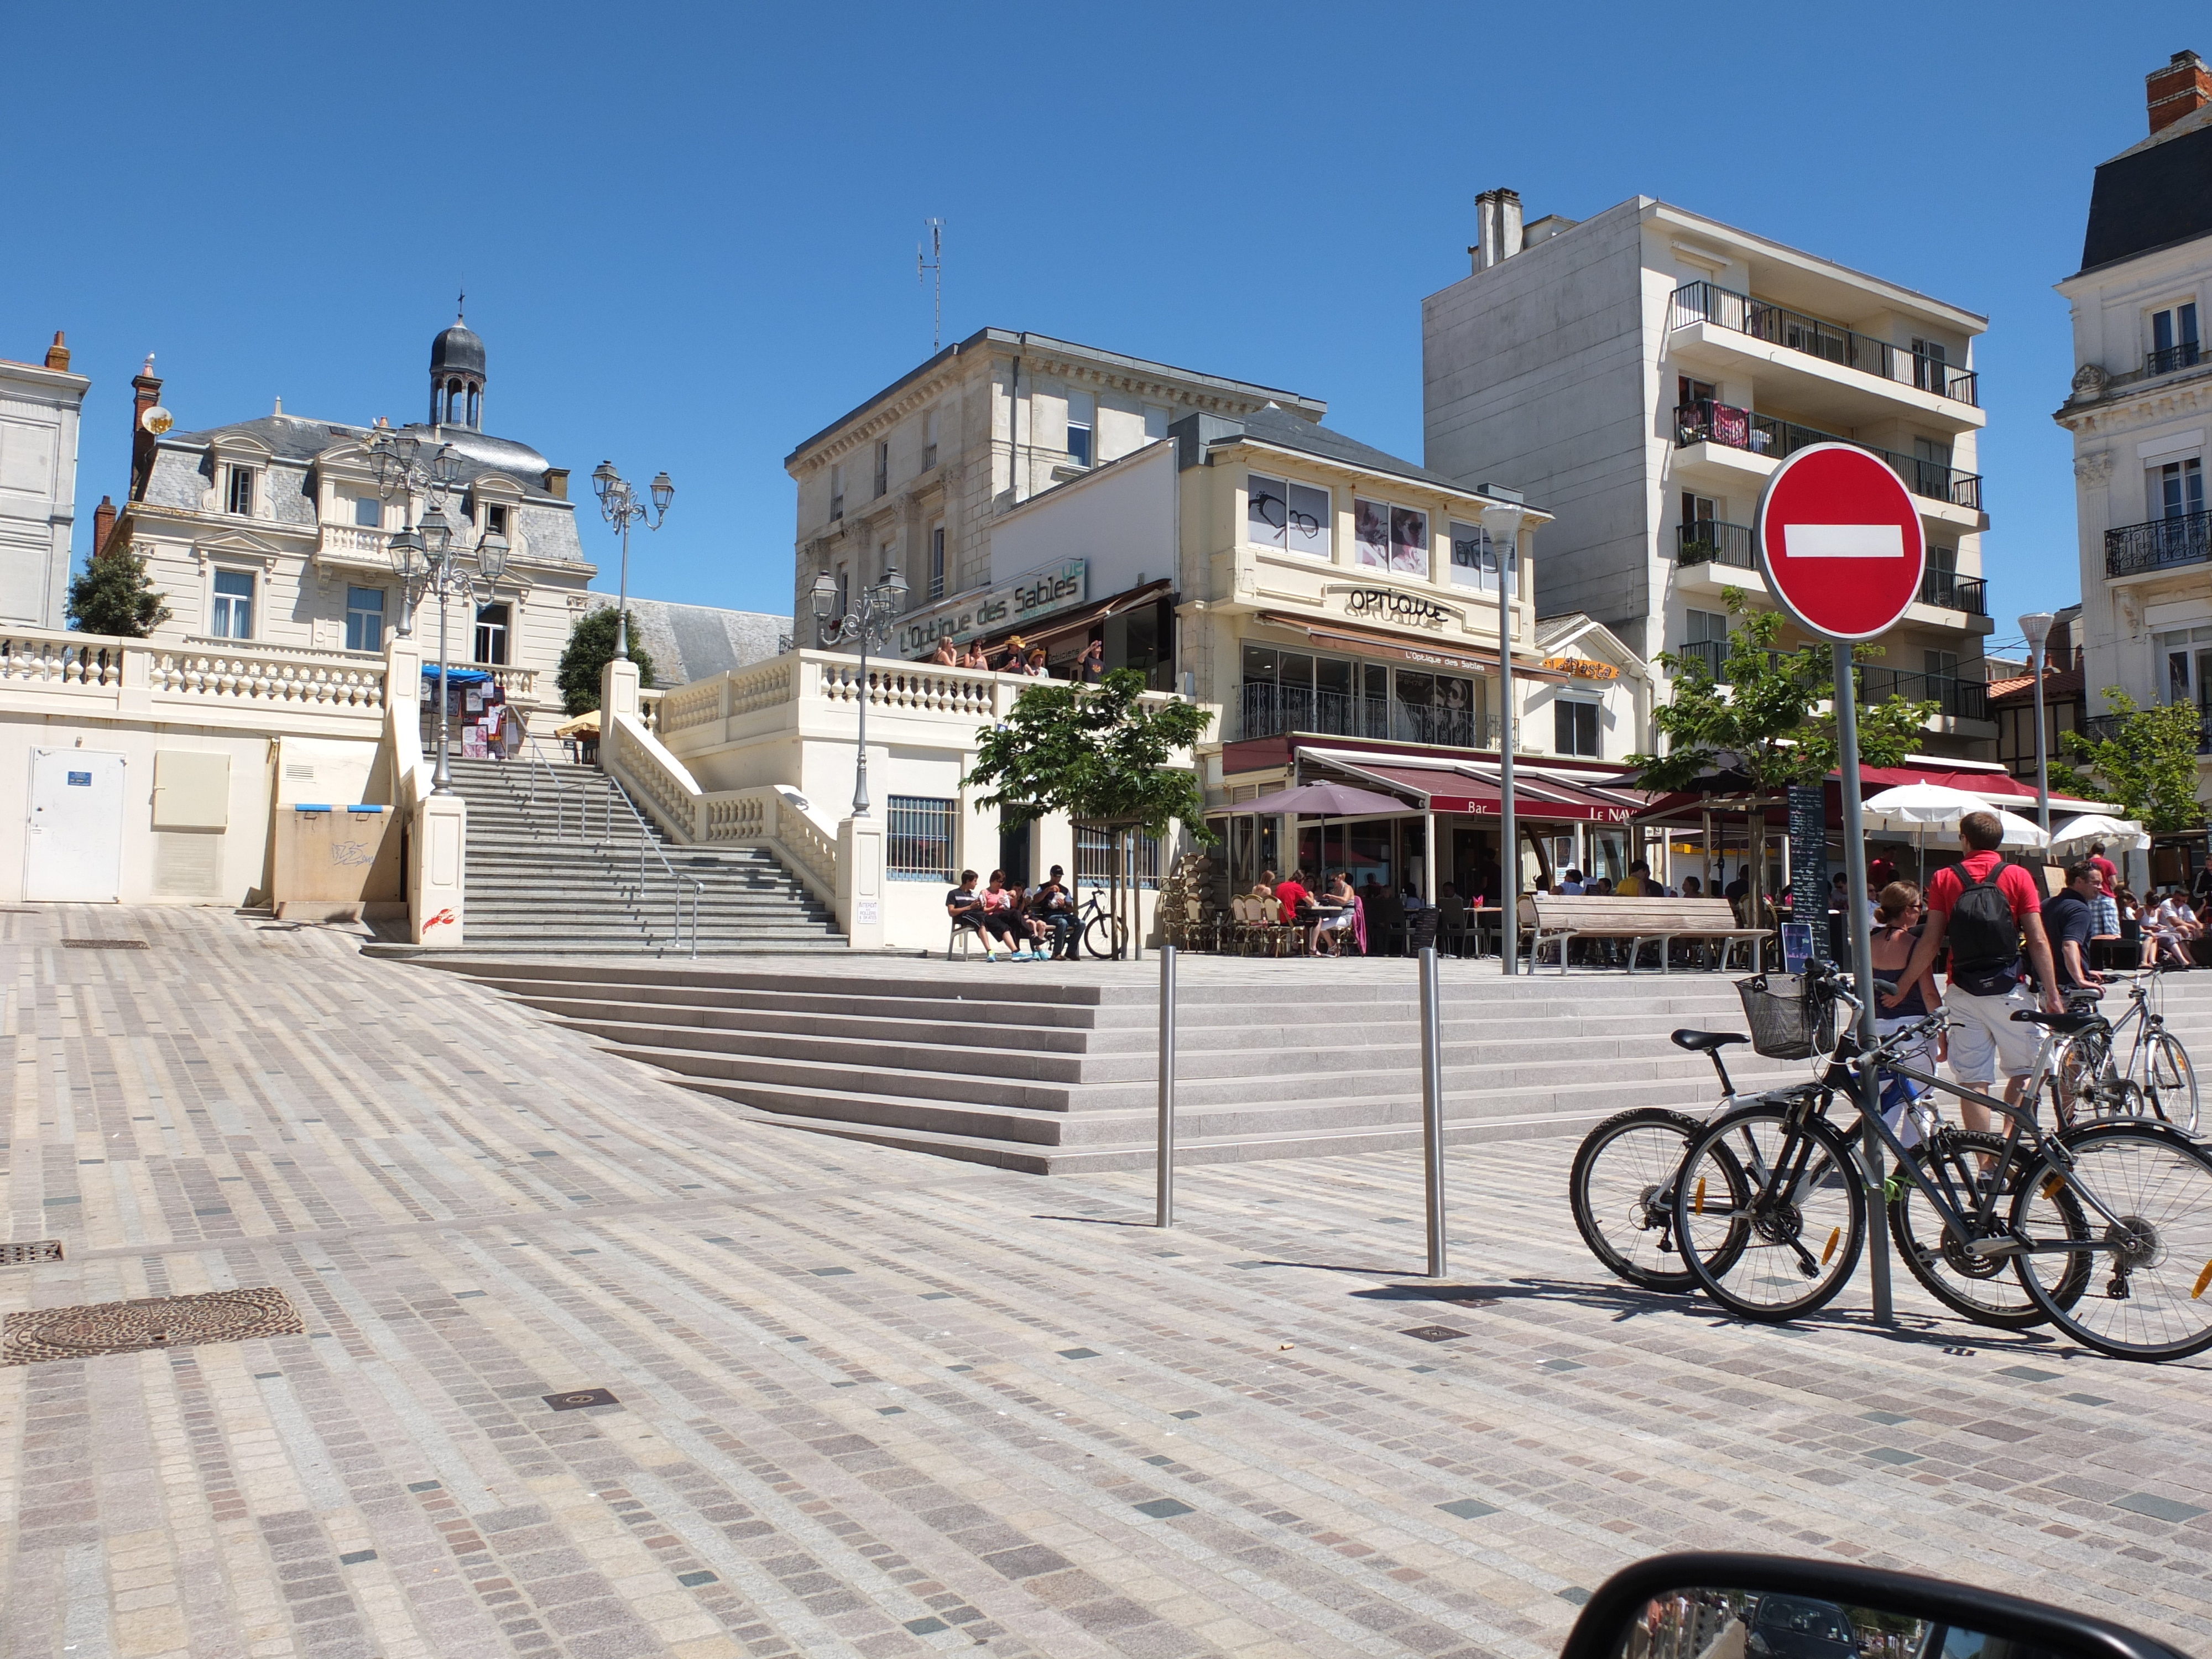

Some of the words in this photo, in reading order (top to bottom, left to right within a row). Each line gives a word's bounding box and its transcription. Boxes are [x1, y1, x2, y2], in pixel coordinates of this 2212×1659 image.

[900, 614, 971, 653] L'Optique
[977, 600, 1007, 626] des
[1015, 576, 1076, 613] Sables
[1405, 651, 1441, 664] L'Optique
[1444, 658, 1458, 666] des
[1462, 660, 1484, 671] Sables
[1468, 801, 1487, 815] Bar
